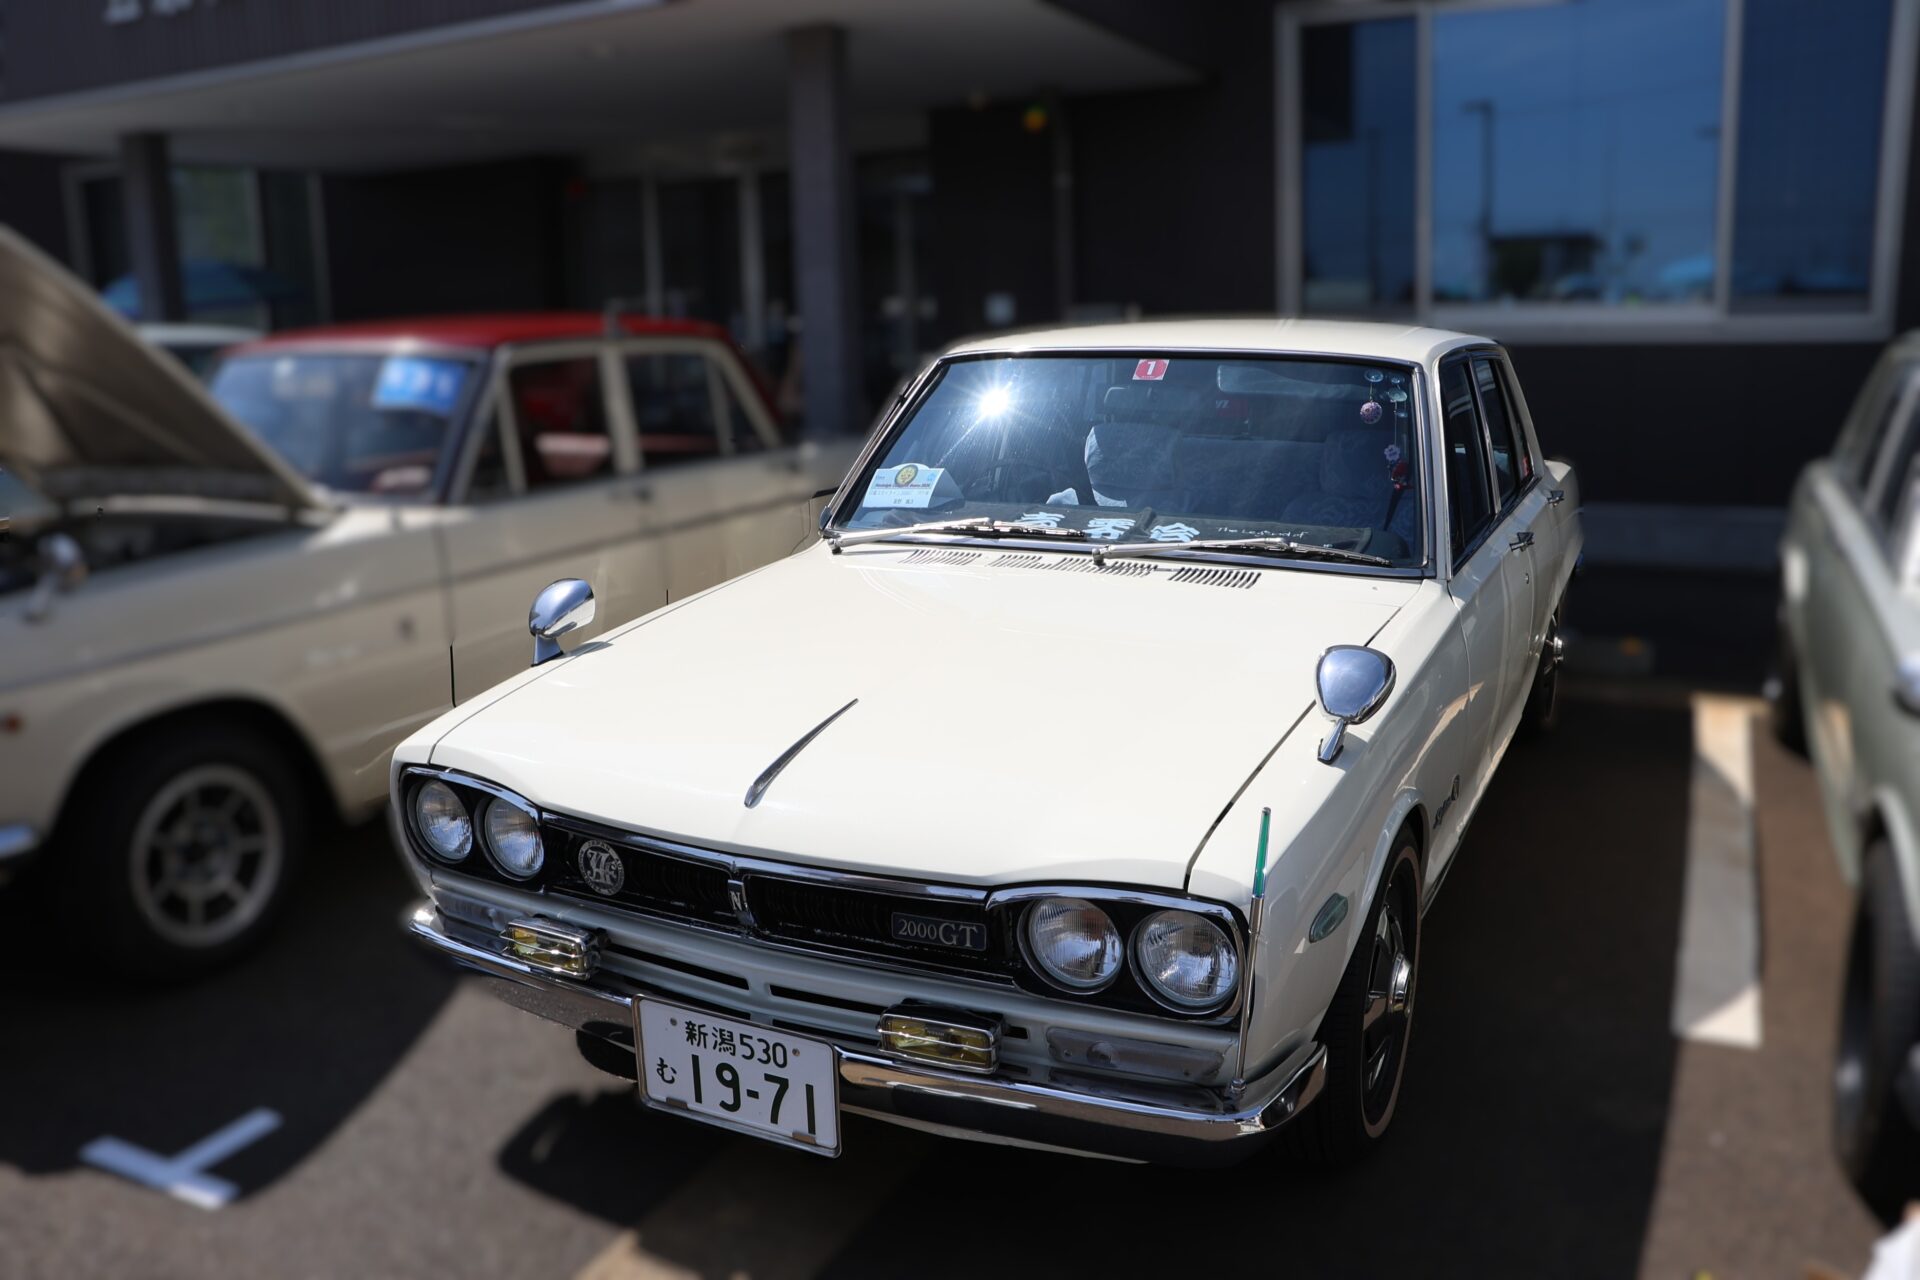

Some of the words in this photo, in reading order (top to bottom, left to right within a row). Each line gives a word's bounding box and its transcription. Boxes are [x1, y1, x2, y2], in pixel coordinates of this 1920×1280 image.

[1146, 360, 1157, 376] 1
[898, 918, 978, 948] 2000GT
[656, 1056, 678, 1085] む
[691, 1054, 817, 1135] 19-71
